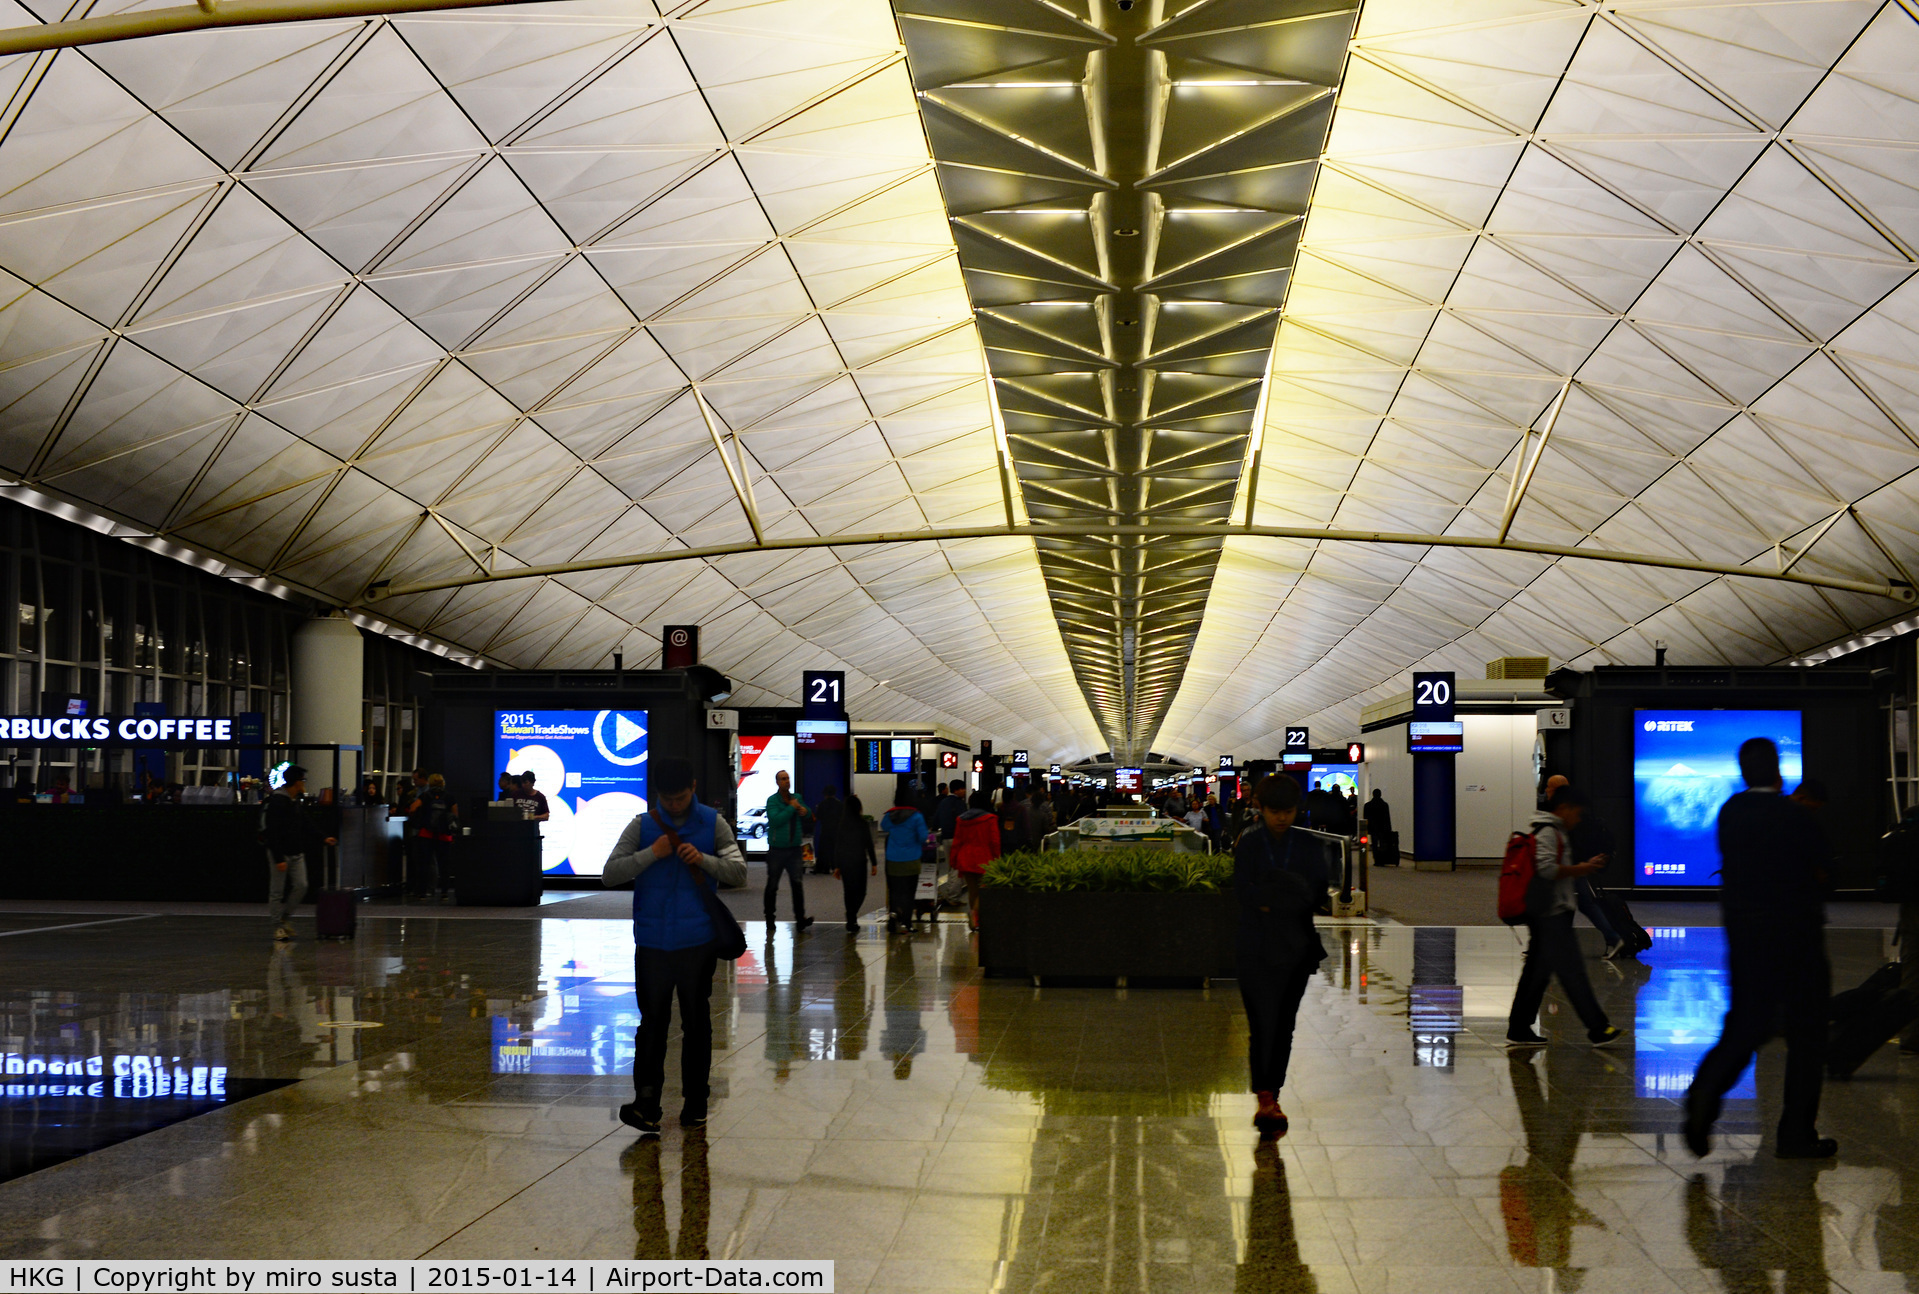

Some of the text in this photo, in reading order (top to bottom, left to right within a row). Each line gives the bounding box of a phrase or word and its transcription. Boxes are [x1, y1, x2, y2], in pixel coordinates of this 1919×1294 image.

[810, 678, 839, 703] 21
[1416, 680, 1450, 705] 20
[500, 713, 534, 725] 2015
[118, 718, 232, 741] COFFEE
[500, 724, 590, 735] TaiwanTradeShows
[1656, 720, 1695, 732] RITEK
[1287, 731, 1306, 746] 22
[1014, 752, 1028, 763] 23
[1220, 757, 1232, 767] 24
[1051, 765, 1061, 773] 25
